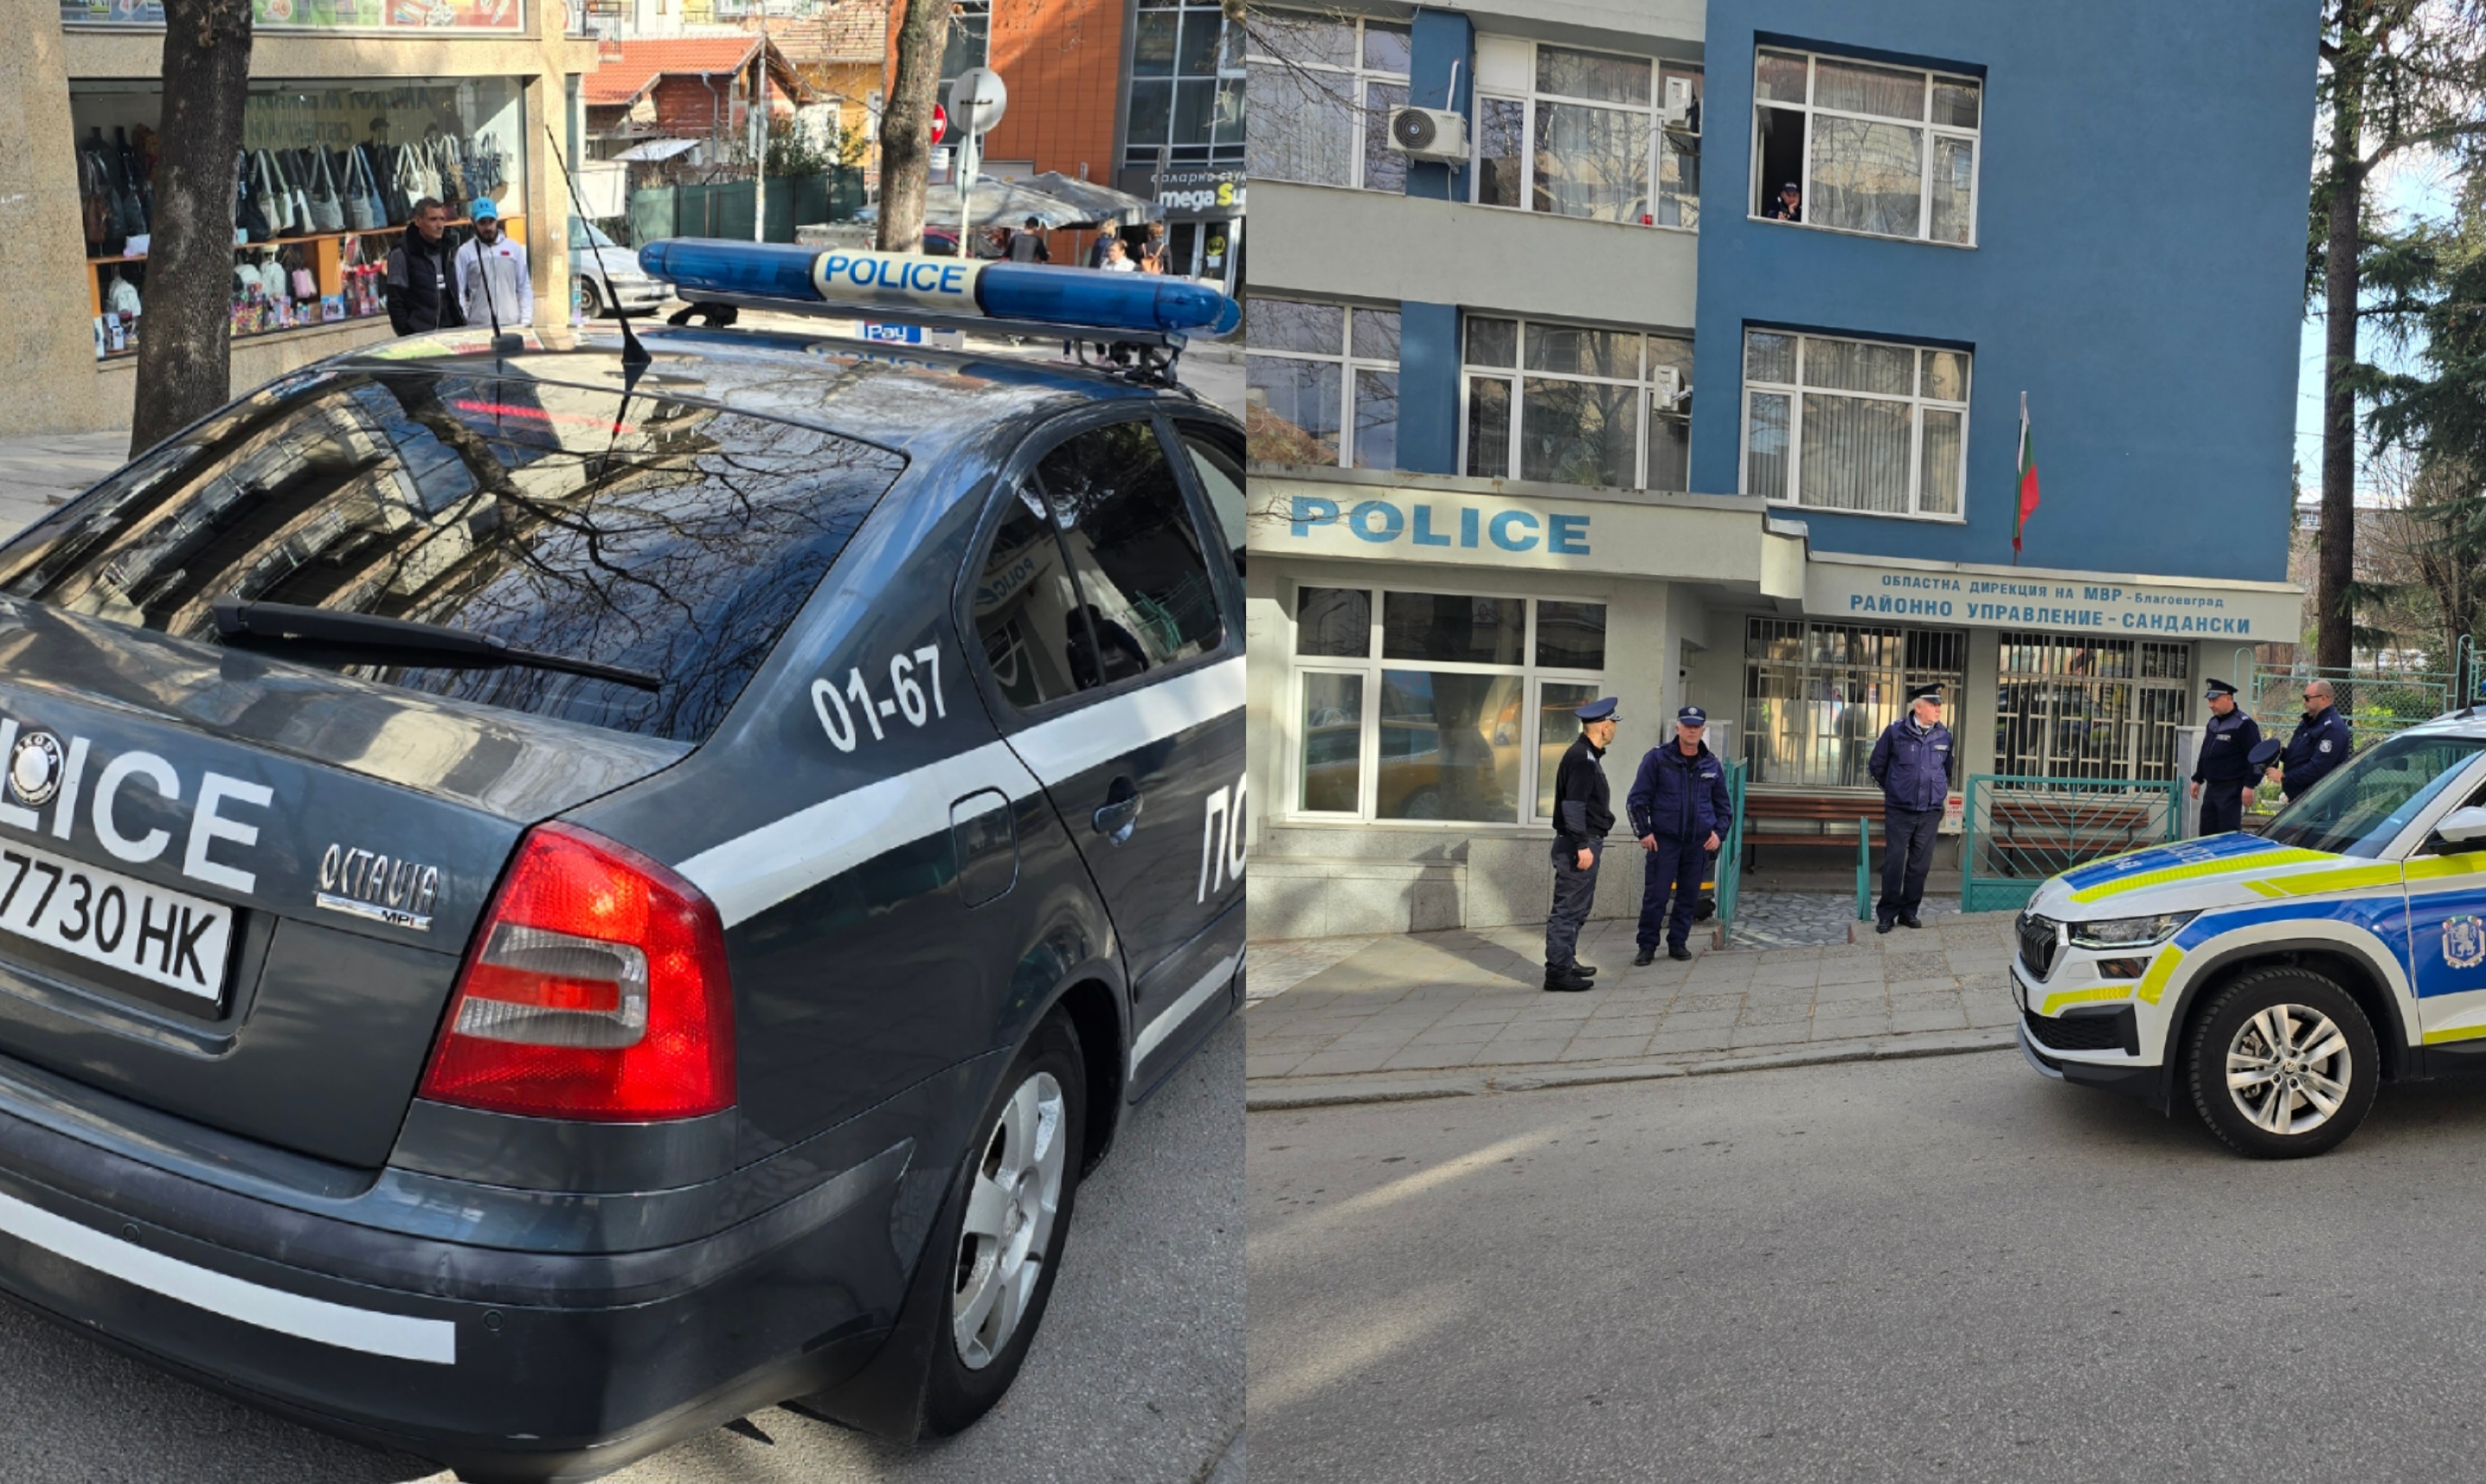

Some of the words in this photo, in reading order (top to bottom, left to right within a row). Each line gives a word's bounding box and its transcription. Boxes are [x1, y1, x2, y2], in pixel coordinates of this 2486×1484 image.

[825, 255, 967, 293] POLICE
[867, 324, 908, 341] Pay
[1290, 495, 1590, 555] POLICE
[1882, 575, 1961, 591] ОБЛАСТНА
[1969, 581, 2047, 597] ДИРЕКЦИЯ
[2055, 588, 2074, 599] НА
[2084, 587, 2123, 601] МВР
[2135, 592, 2224, 608] Благоевград
[1850, 594, 1953, 617] РАЙОННО
[1967, 602, 2103, 626] УПРАВЛЕНИЕ
[2122, 613, 2250, 634] САНДАНСКИ
[811, 644, 947, 753] 01-67
[0, 717, 274, 895] LICE
[320, 842, 438, 915] OCTAVIA
[382, 909, 415, 927] MPI
